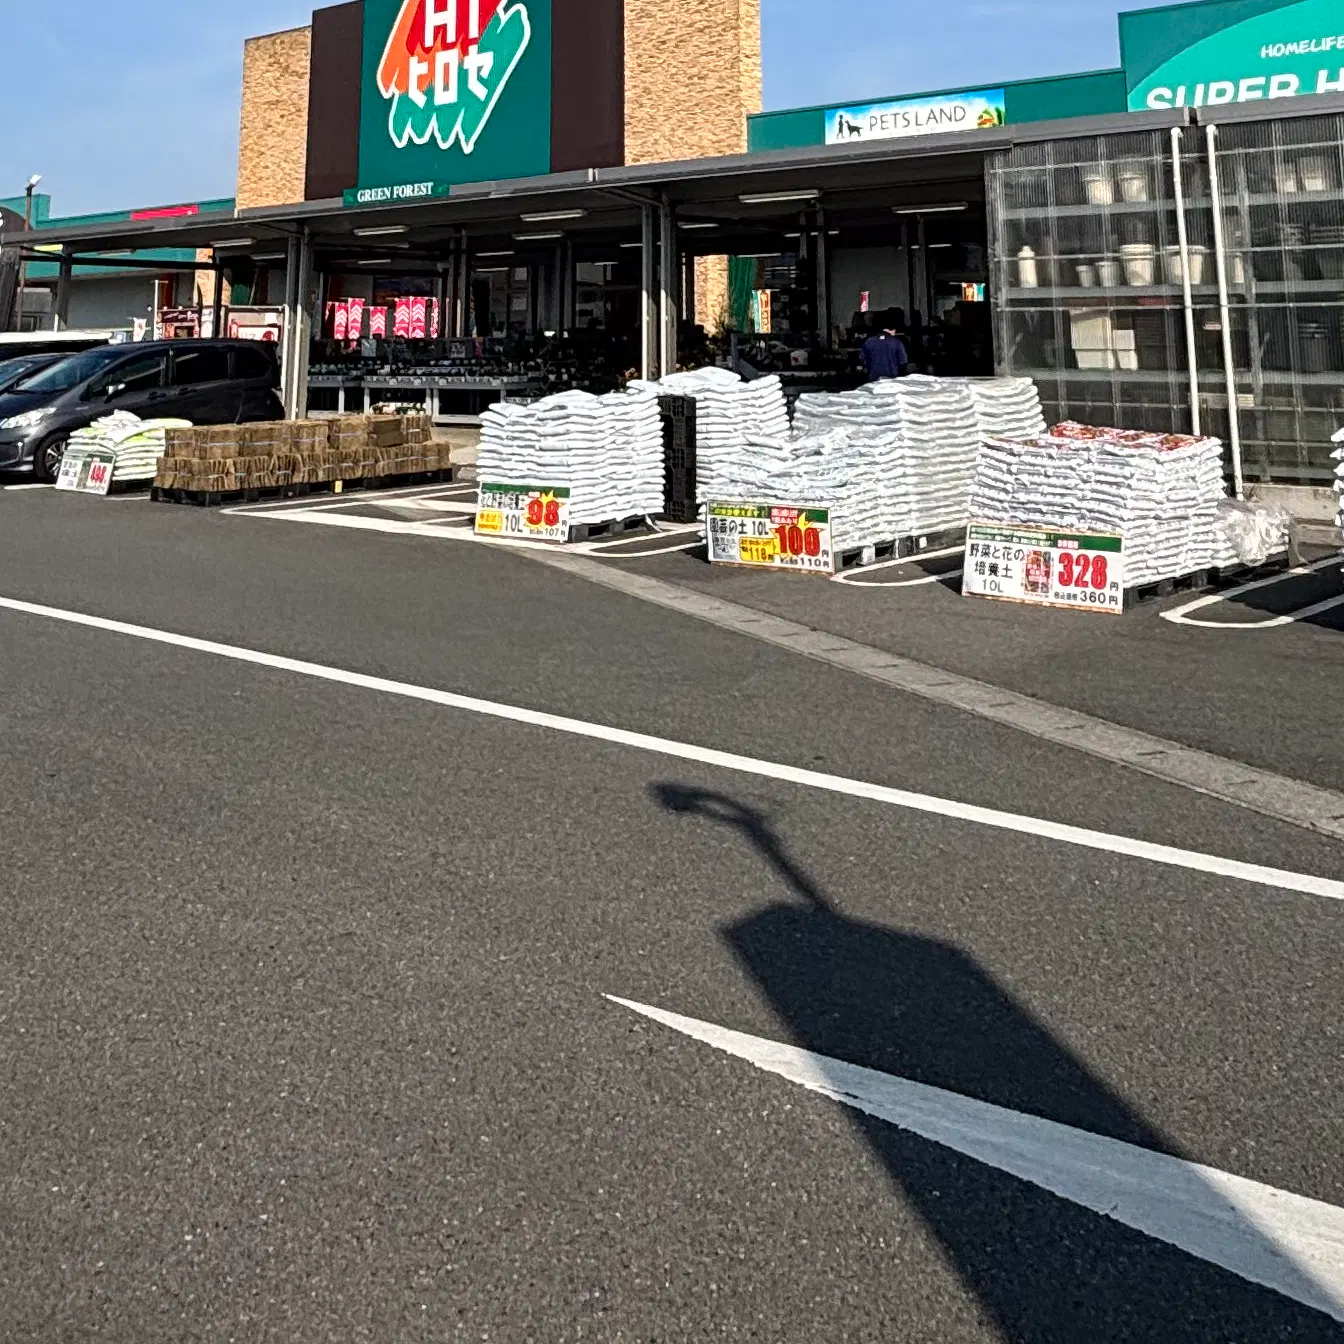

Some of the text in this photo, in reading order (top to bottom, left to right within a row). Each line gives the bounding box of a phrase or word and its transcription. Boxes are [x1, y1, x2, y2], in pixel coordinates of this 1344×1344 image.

[408, 44, 494, 109] ヒロセ
[357, 181, 434, 202] GREEN FOREST
[527, 499, 560, 526] 98
[505, 514, 523, 533] 10L
[752, 520, 769, 536] 10L
[775, 524, 821, 557] 100
[969, 543, 1025, 562] 野菜と花の
[974, 560, 1013, 579] 培養土
[1058, 552, 1108, 590] 328
[982, 579, 1004, 593] 10L
